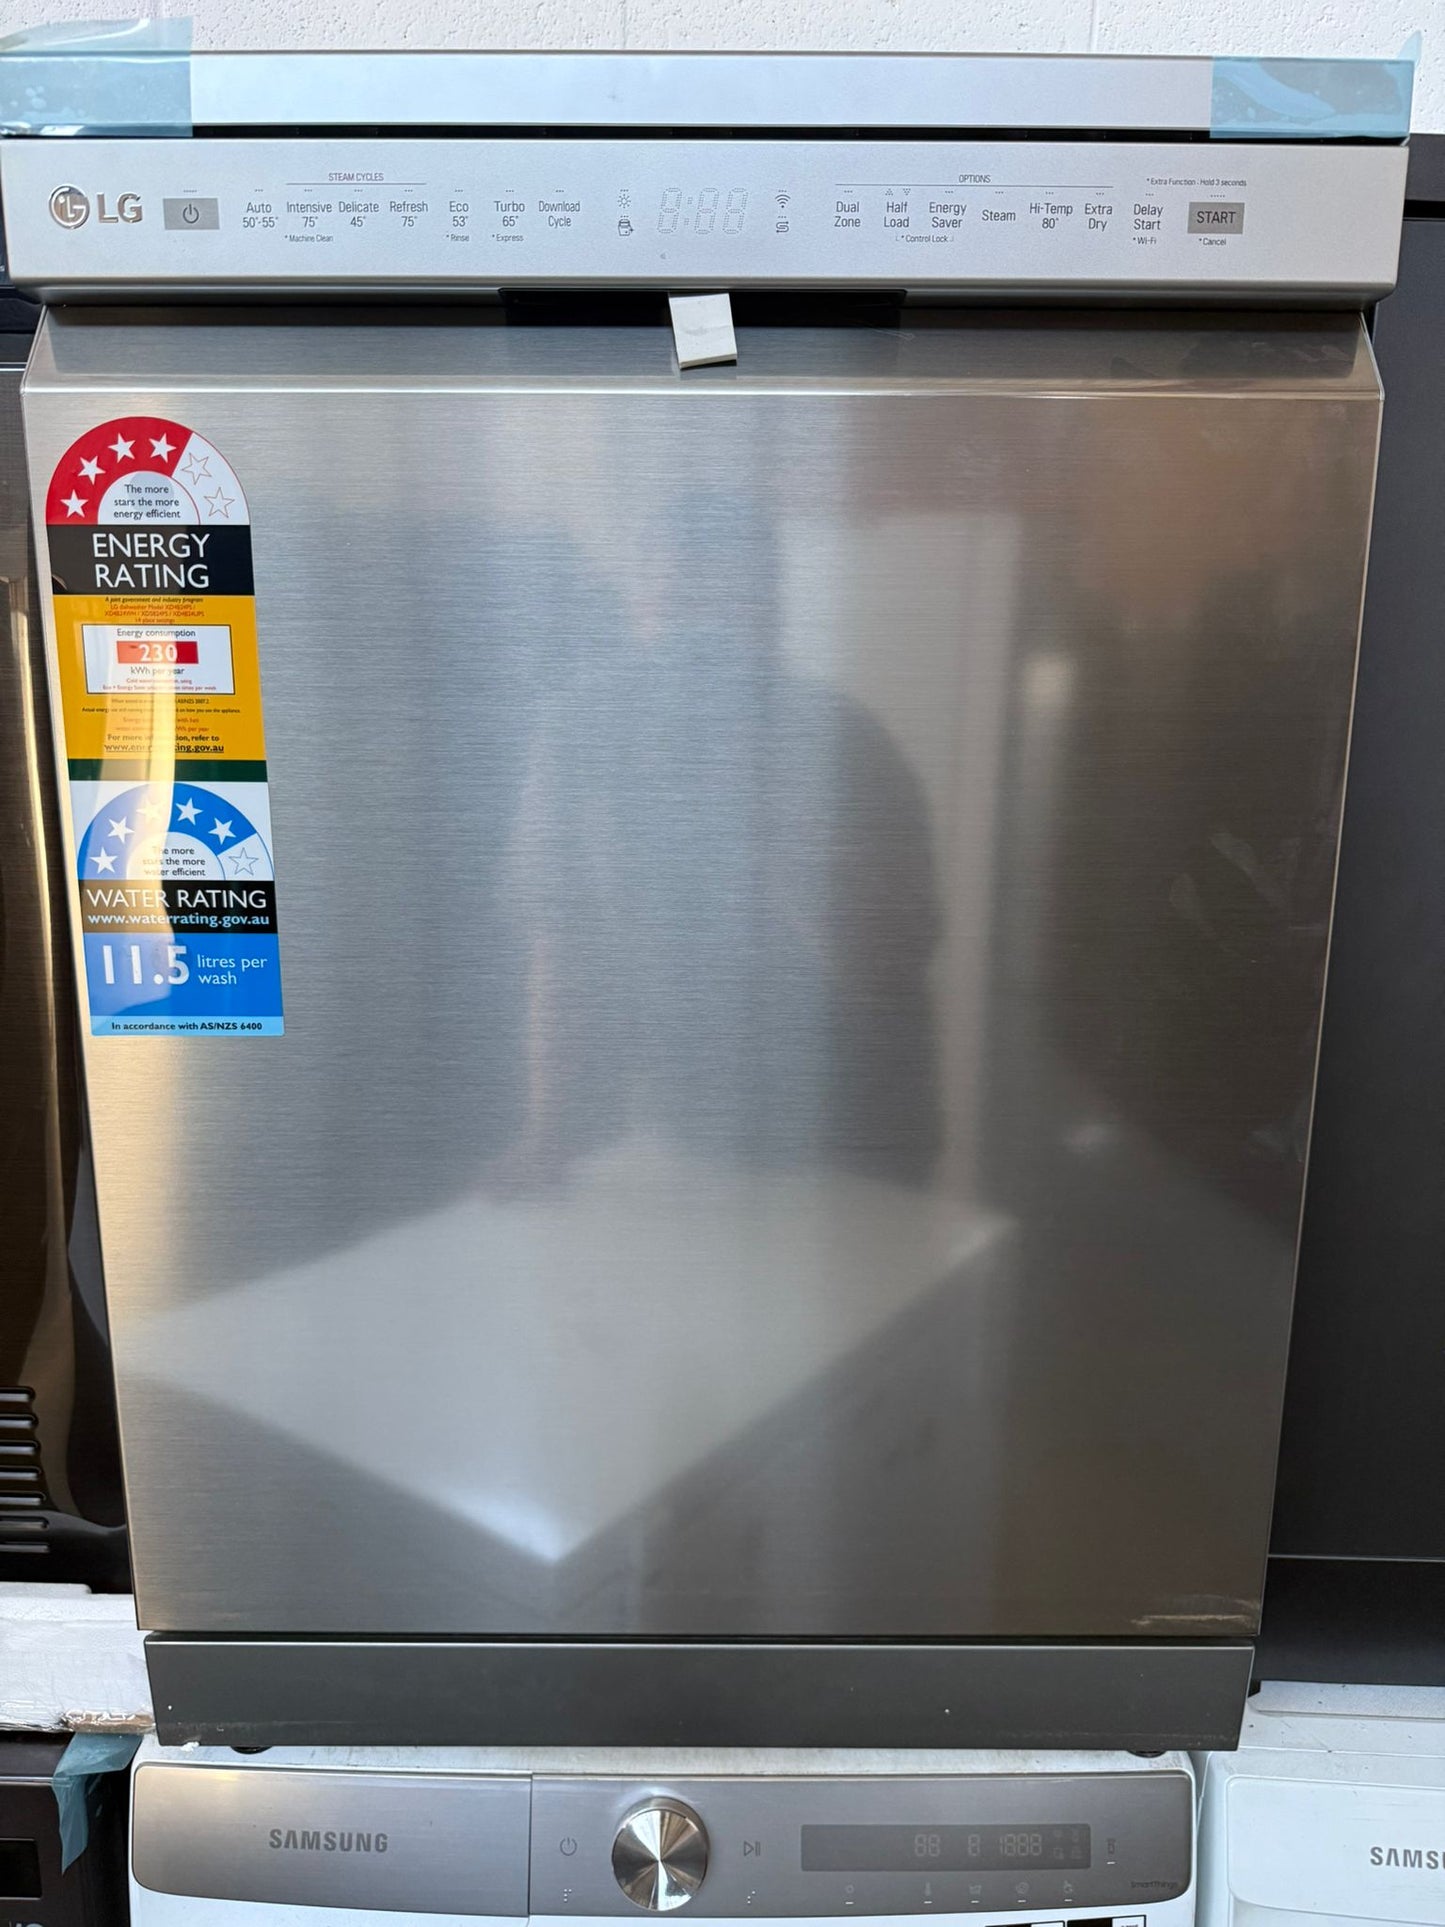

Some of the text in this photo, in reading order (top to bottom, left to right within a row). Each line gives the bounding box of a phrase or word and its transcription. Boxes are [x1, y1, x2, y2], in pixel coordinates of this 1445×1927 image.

[328, 173, 384, 182] STEAM CYCLES
[958, 174, 991, 183] OPTIONS
[1150, 178, 1167, 186] Extra
[1168, 178, 1196, 186] Function
[1199, 178, 1215, 186] Hold
[1220, 178, 1247, 187] seconds
[97, 191, 143, 224] LG
[246, 201, 272, 213] Auto
[286, 201, 333, 213] Intensive
[338, 201, 380, 213] Delicate
[389, 201, 429, 213] Refresh
[449, 201, 469, 213] Eco
[493, 201, 526, 213] Turbo
[538, 200, 581, 213] Download
[836, 201, 860, 213] Dual
[886, 201, 908, 213] Half
[929, 202, 967, 216] Energy
[1029, 202, 1073, 217] Hi-Temp
[1084, 203, 1113, 215] Extra
[1133, 203, 1163, 218] Delay
[981, 209, 1017, 222] Steam
[1196, 210, 1237, 225] START
[548, 216, 572, 228] Cycle
[834, 216, 861, 228] Zone
[883, 216, 910, 228] Load
[931, 217, 963, 229] Saver
[1088, 218, 1108, 232] Dry
[1133, 218, 1161, 231] Start
[289, 234, 334, 243] Machine Clean
[450, 234, 470, 242] Rinse
[496, 234, 524, 243] Express
[905, 234, 949, 243] Control Lock
[1137, 236, 1157, 245] Wi-Fi
[1202, 237, 1227, 246] Cancel
[124, 484, 169, 494] The more
[114, 498, 180, 507] stars the more
[113, 509, 181, 521] energy efficient
[92, 532, 210, 558] ENERGY
[94, 563, 210, 589] RATING
[116, 628, 196, 638] Energy consumption
[137, 643, 178, 662] 230
[130, 666, 151, 675] kWh
[171, 847, 195, 855] more
[165, 857, 181, 866] the
[182, 858, 206, 866] more
[172, 867, 206, 877] efficient
[86, 889, 267, 909] WATER RATING
[87, 912, 270, 928] www.waterrating.gov.au
[102, 944, 190, 985] 11.5
[196, 954, 268, 972] litres per
[198, 971, 237, 985] wash
[111, 1022, 263, 1031] In accordance with AS/NZS 6400
[269, 1828, 389, 1853] SAMSUNG
[1370, 1846, 1445, 1870] SAMS
